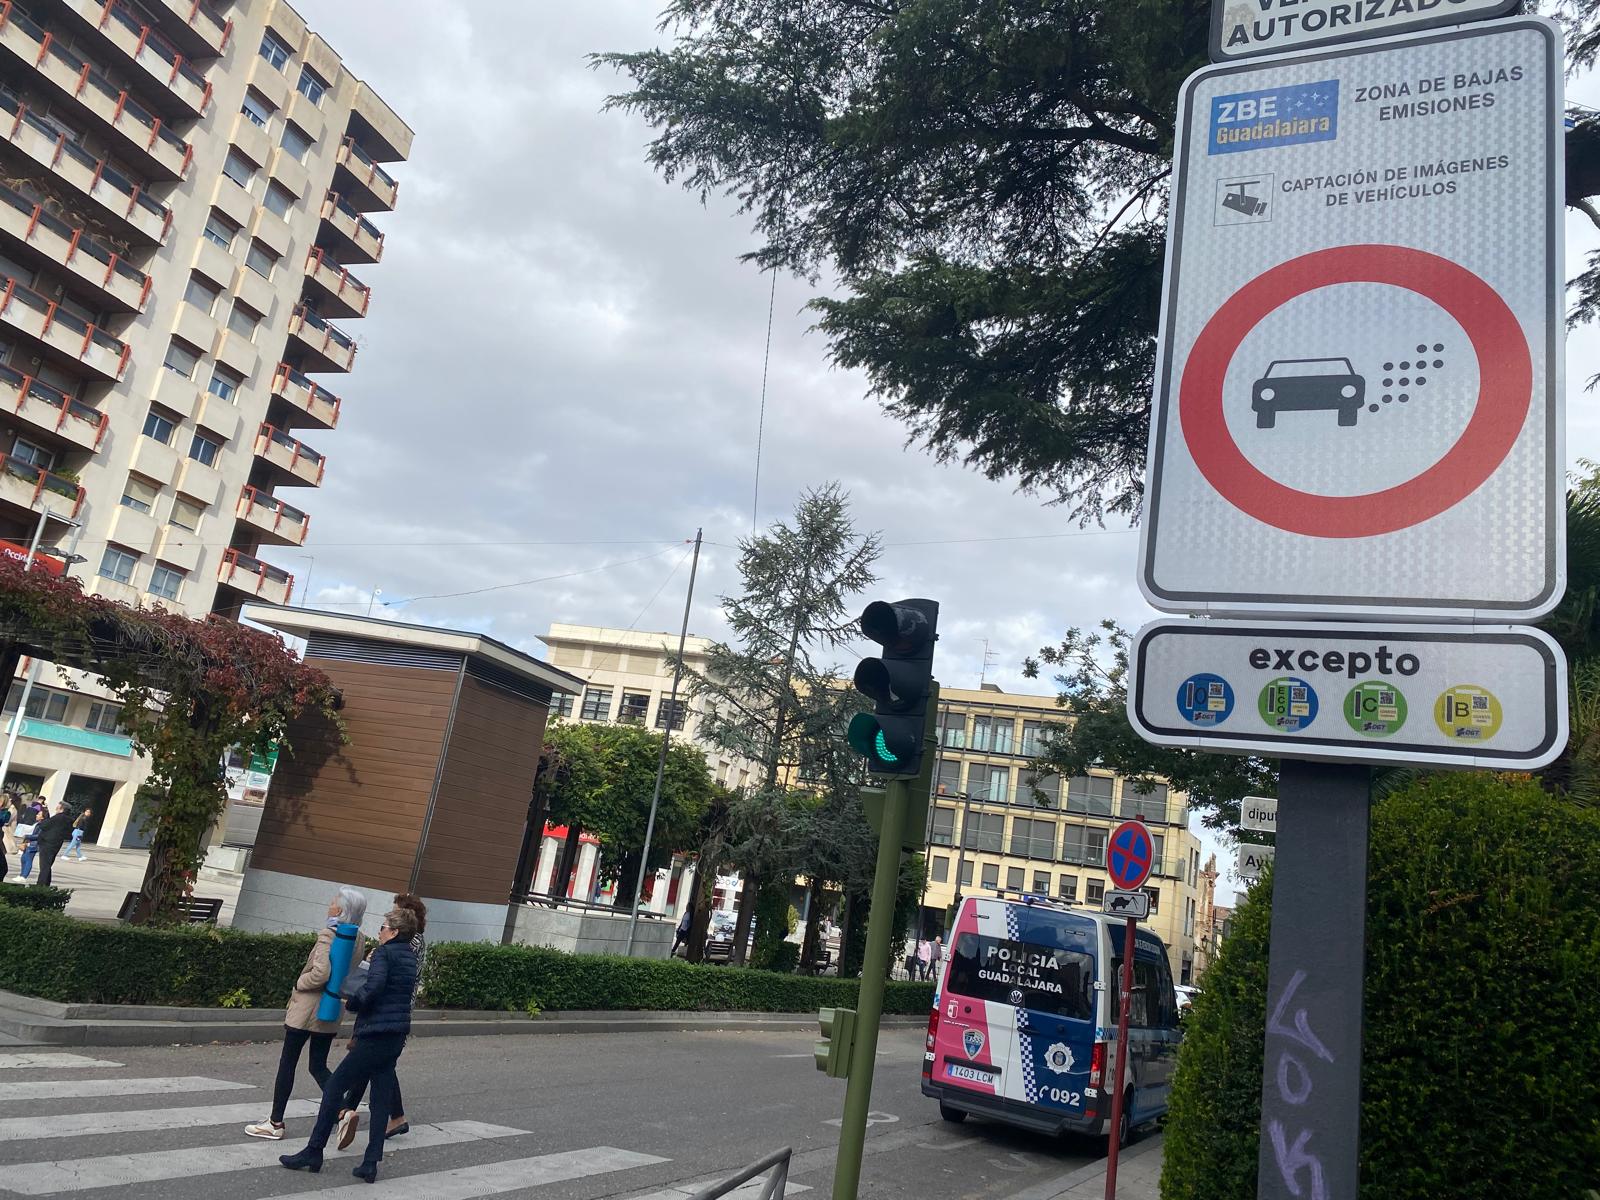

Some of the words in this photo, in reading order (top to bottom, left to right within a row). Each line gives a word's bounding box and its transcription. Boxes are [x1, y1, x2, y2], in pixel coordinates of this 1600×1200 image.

[1226, 0, 1466, 47] AUTORIZAD
[1354, 82, 1411, 102] ZONA
[1418, 76, 1446, 94] DE
[1453, 65, 1524, 89] BAJAS
[1217, 95, 1278, 124] ZBE
[1379, 92, 1496, 121] EMISIONES
[1281, 169, 1378, 193] CAPTACIÓN
[1384, 167, 1408, 182] DE
[1413, 155, 1510, 178] IMÁGENES
[1326, 192, 1349, 207] DE
[1354, 181, 1457, 204] VEHÍCULOS
[1249, 645, 1420, 679] excepto
[1362, 697, 1378, 713] C
[1455, 702, 1470, 717] B
[1248, 807, 1276, 823] dipu
[1245, 855, 1264, 870] Ay
[978, 969, 1063, 994] GUADALAJARA
[1002, 962, 1040, 978] LOCAL
[955, 1066, 975, 1078] 1403
[976, 1072, 994, 1084] LCM
[1050, 1087, 1081, 1107] 092
